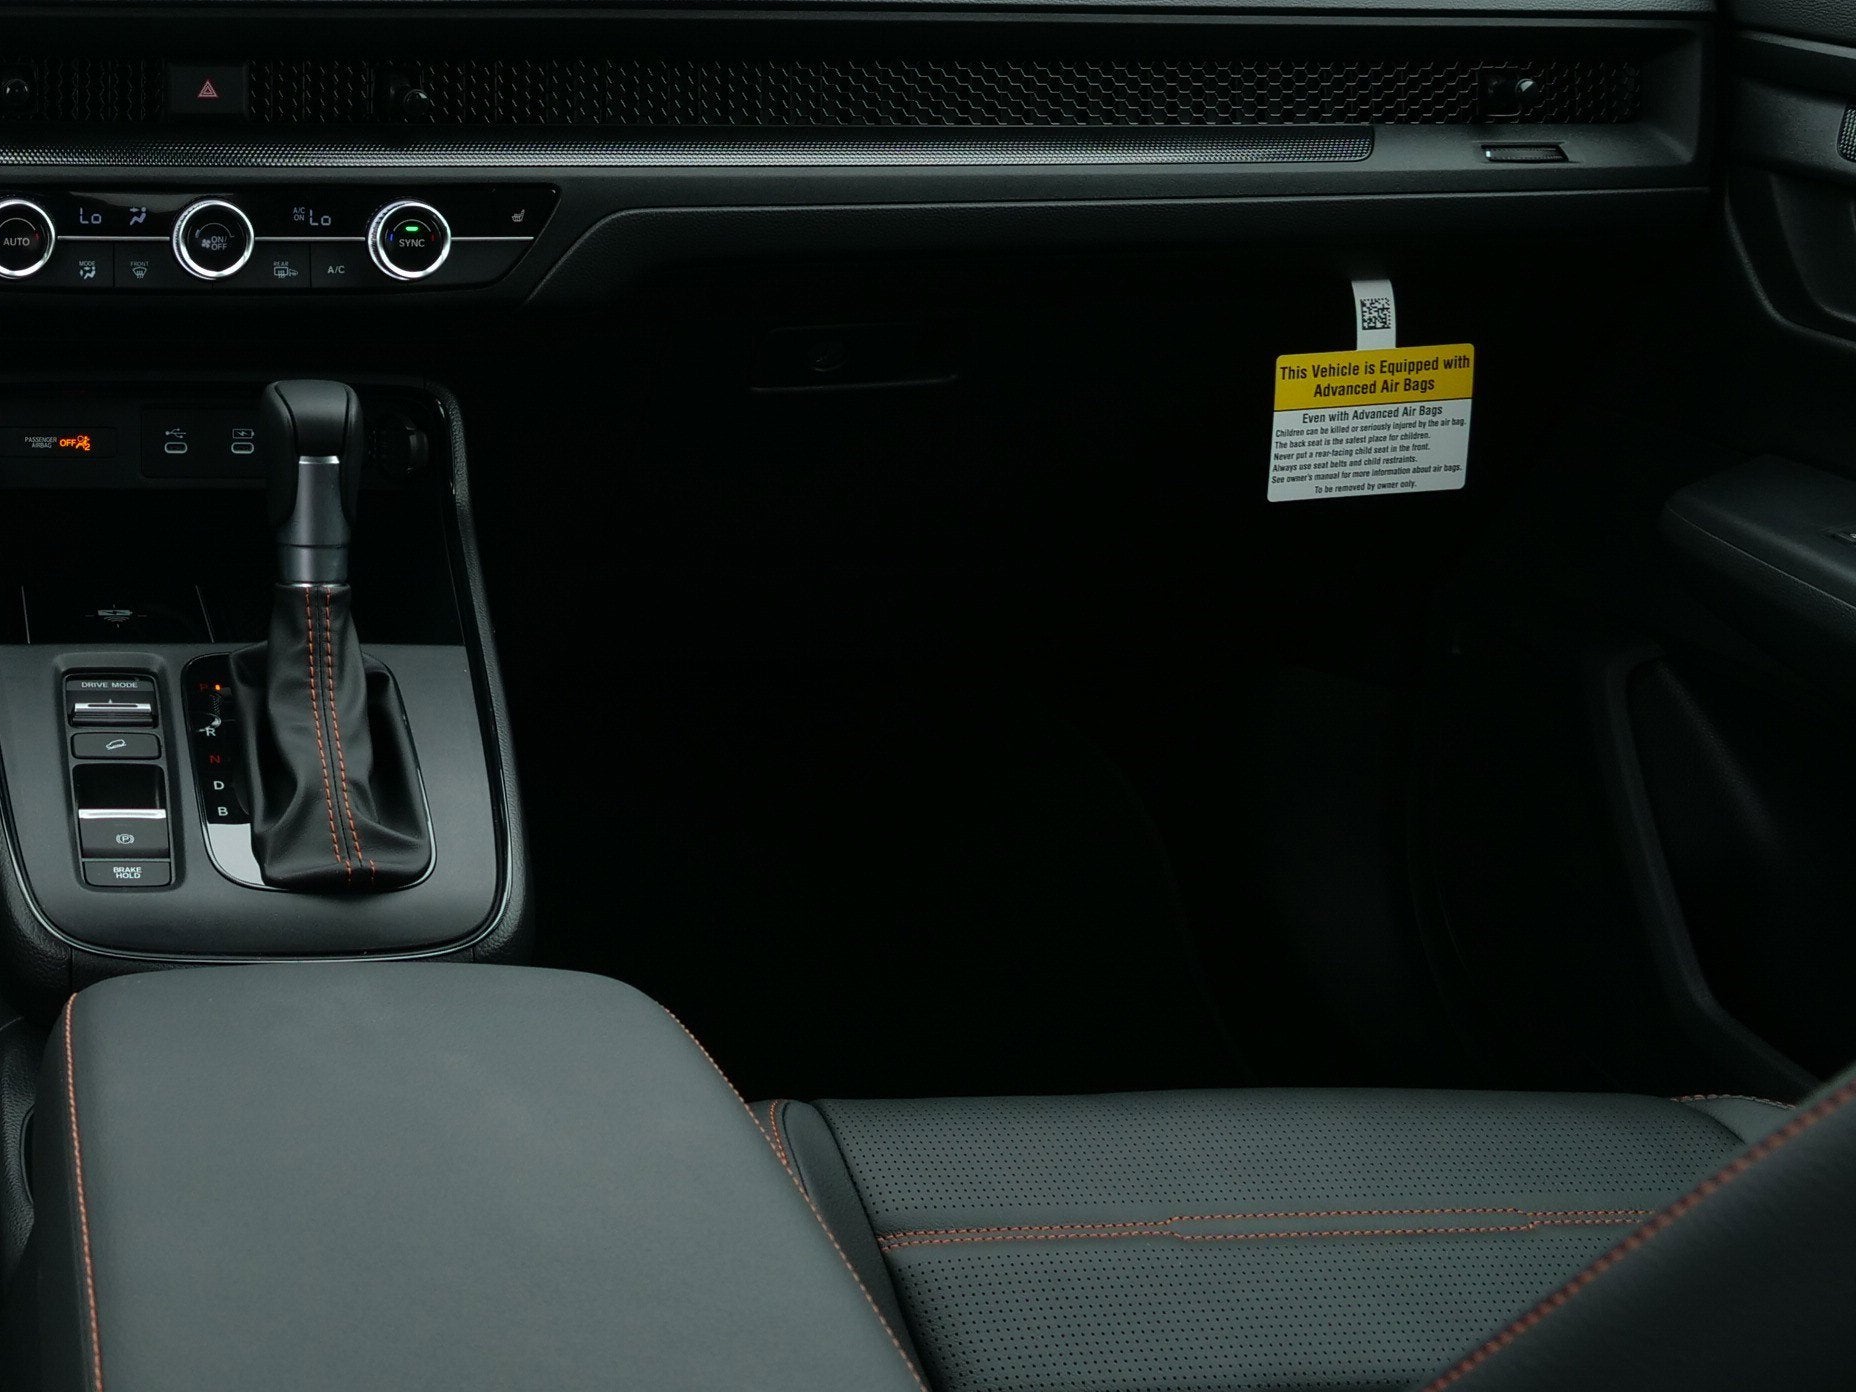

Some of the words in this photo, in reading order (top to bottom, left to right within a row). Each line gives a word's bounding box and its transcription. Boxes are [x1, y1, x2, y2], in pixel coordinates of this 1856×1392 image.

[79, 207, 102, 224] Lo
[309, 209, 331, 226] Lo
[3, 237, 30, 246] AUTO
[211, 235, 228, 243] ON/
[398, 238, 425, 248] SYNC
[211, 243, 227, 251] OFF
[327, 265, 345, 274] A/C
[1280, 365, 1307, 380] This
[1312, 361, 1360, 378] Vehicle
[1364, 360, 1375, 375] is
[1379, 356, 1439, 375] Equipped
[1443, 354, 1470, 369] with
[1313, 381, 1376, 398] Advanced
[1380, 379, 1398, 393] Air
[1403, 377, 1436, 394] Bags
[1302, 413, 1326, 424] Even
[1328, 411, 1349, 423] with
[1351, 408, 1399, 421] Advanced
[1402, 406, 1417, 417] Air
[1419, 405, 1443, 418] Bags
[1275, 428, 1305, 438] Children
[1319, 426, 1329, 435] be
[1330, 424, 1350, 434] killed
[1360, 422, 1391, 434] seriously
[1392, 420, 1417, 432] injured
[1419, 419, 1427, 430] by
[1428, 418, 1439, 428] the
[1440, 418, 1450, 427] air
[1451, 416, 1467, 428] bag.
[59, 438, 76, 447] OFF
[1314, 485, 1323, 494] To
[1324, 484, 1333, 493] be
[1335, 483, 1366, 493] removed
[1367, 482, 1376, 492] by
[1377, 481, 1399, 490] owner
[1400, 479, 1417, 490] only.
[206, 728, 216, 737] R
[209, 755, 221, 764] N
[213, 781, 225, 790] D
[217, 807, 229, 816] B
